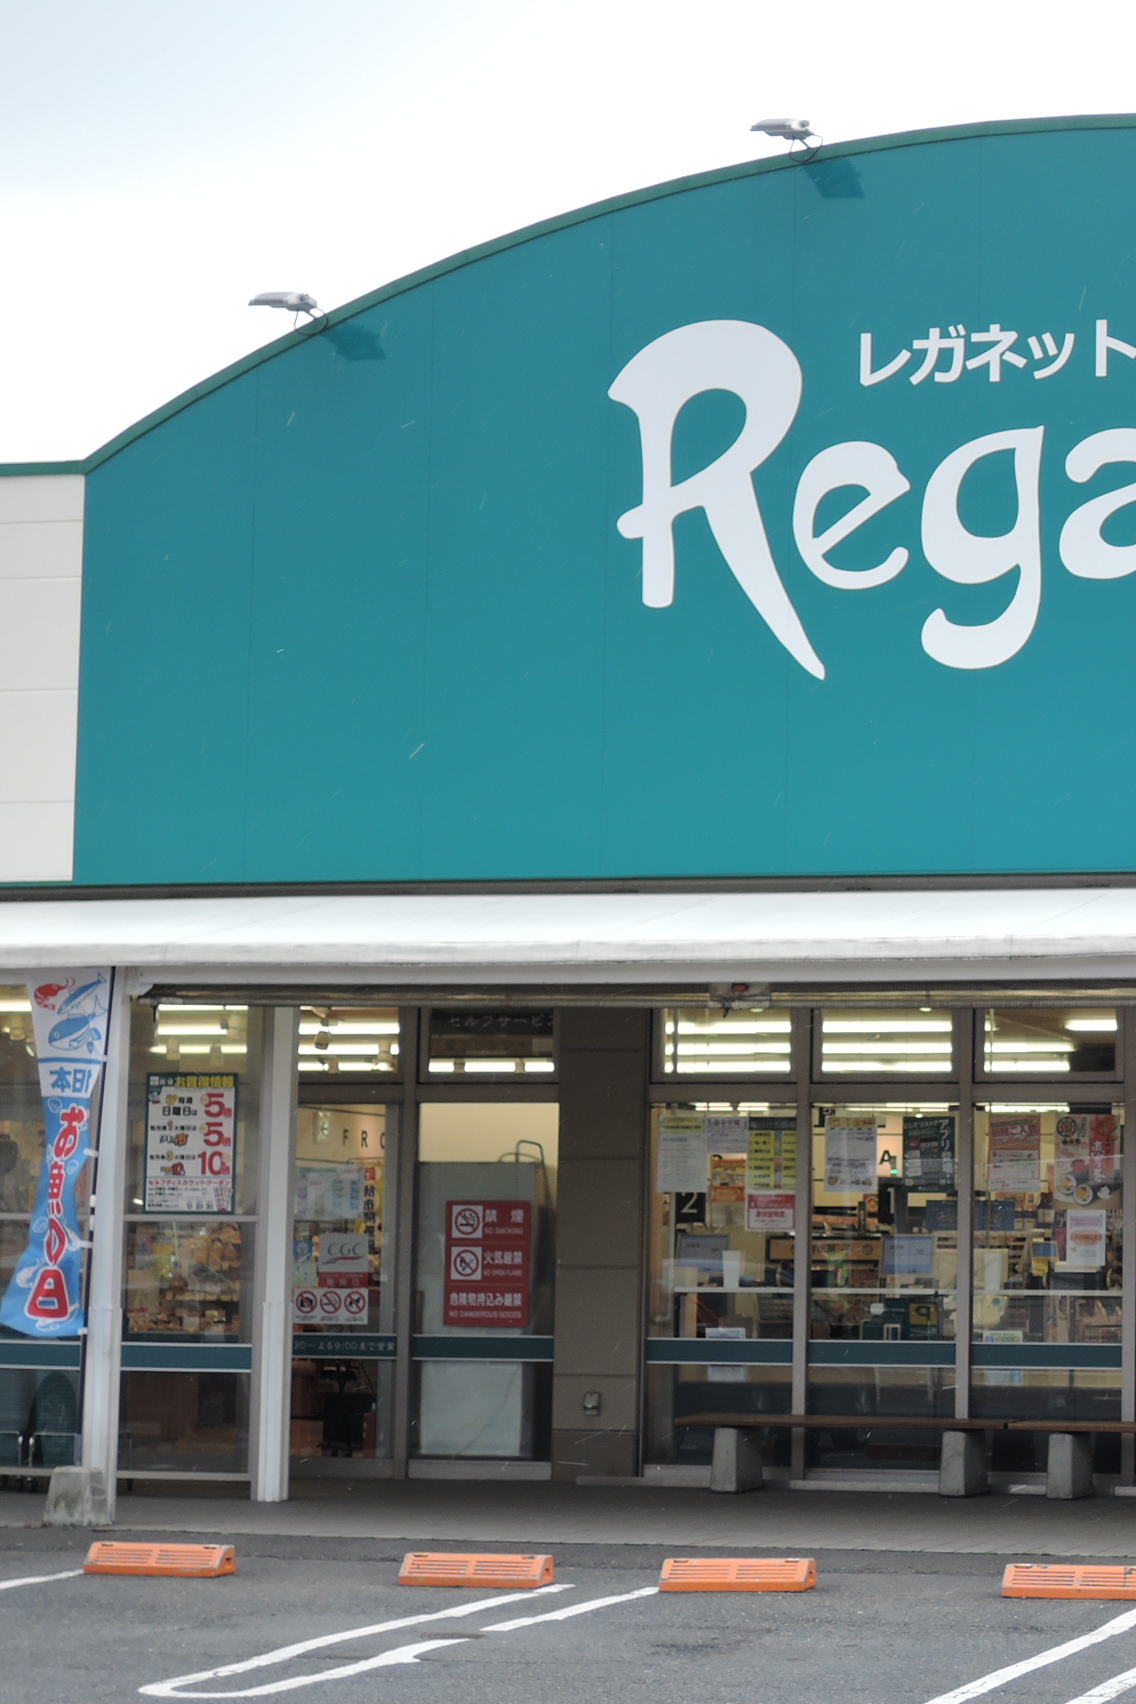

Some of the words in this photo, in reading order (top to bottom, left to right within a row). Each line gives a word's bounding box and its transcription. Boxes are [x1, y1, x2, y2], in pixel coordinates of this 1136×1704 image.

[484, 1209, 524, 1223] 禁煙
[327, 1242, 364, 1257] CGC
[484, 1251, 523, 1265] 火気厳禁
